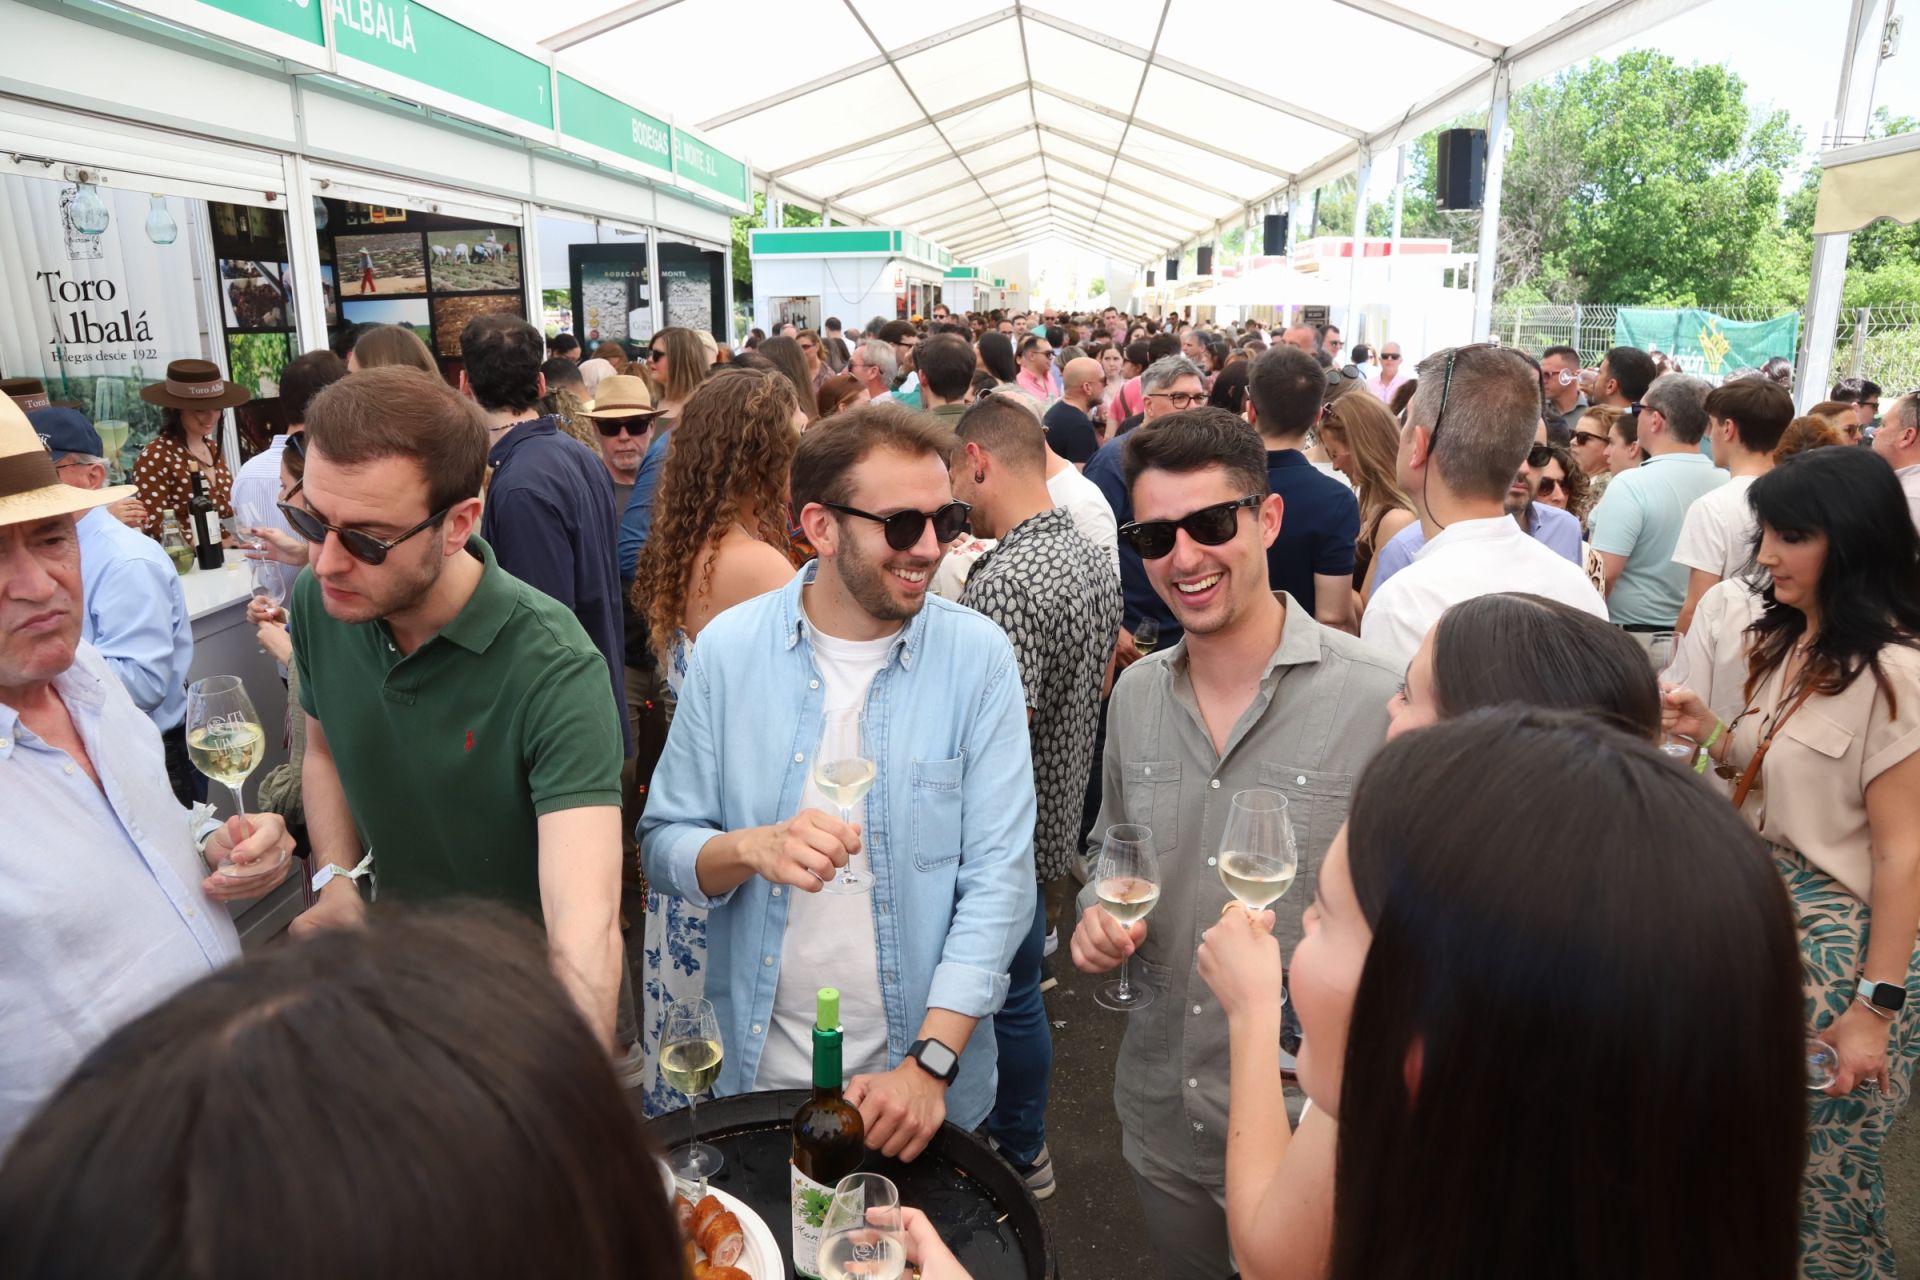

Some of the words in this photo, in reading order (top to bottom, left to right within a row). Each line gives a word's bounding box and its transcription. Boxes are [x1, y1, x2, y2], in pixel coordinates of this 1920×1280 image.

[333, 0, 417, 54] ALBALÁ
[631, 118, 669, 156] BODEGAS
[36, 270, 116, 302] Toro
[132, 348, 158, 360] 1922
[188, 386, 209, 394] Toro
[24, 399, 46, 408] Toro
